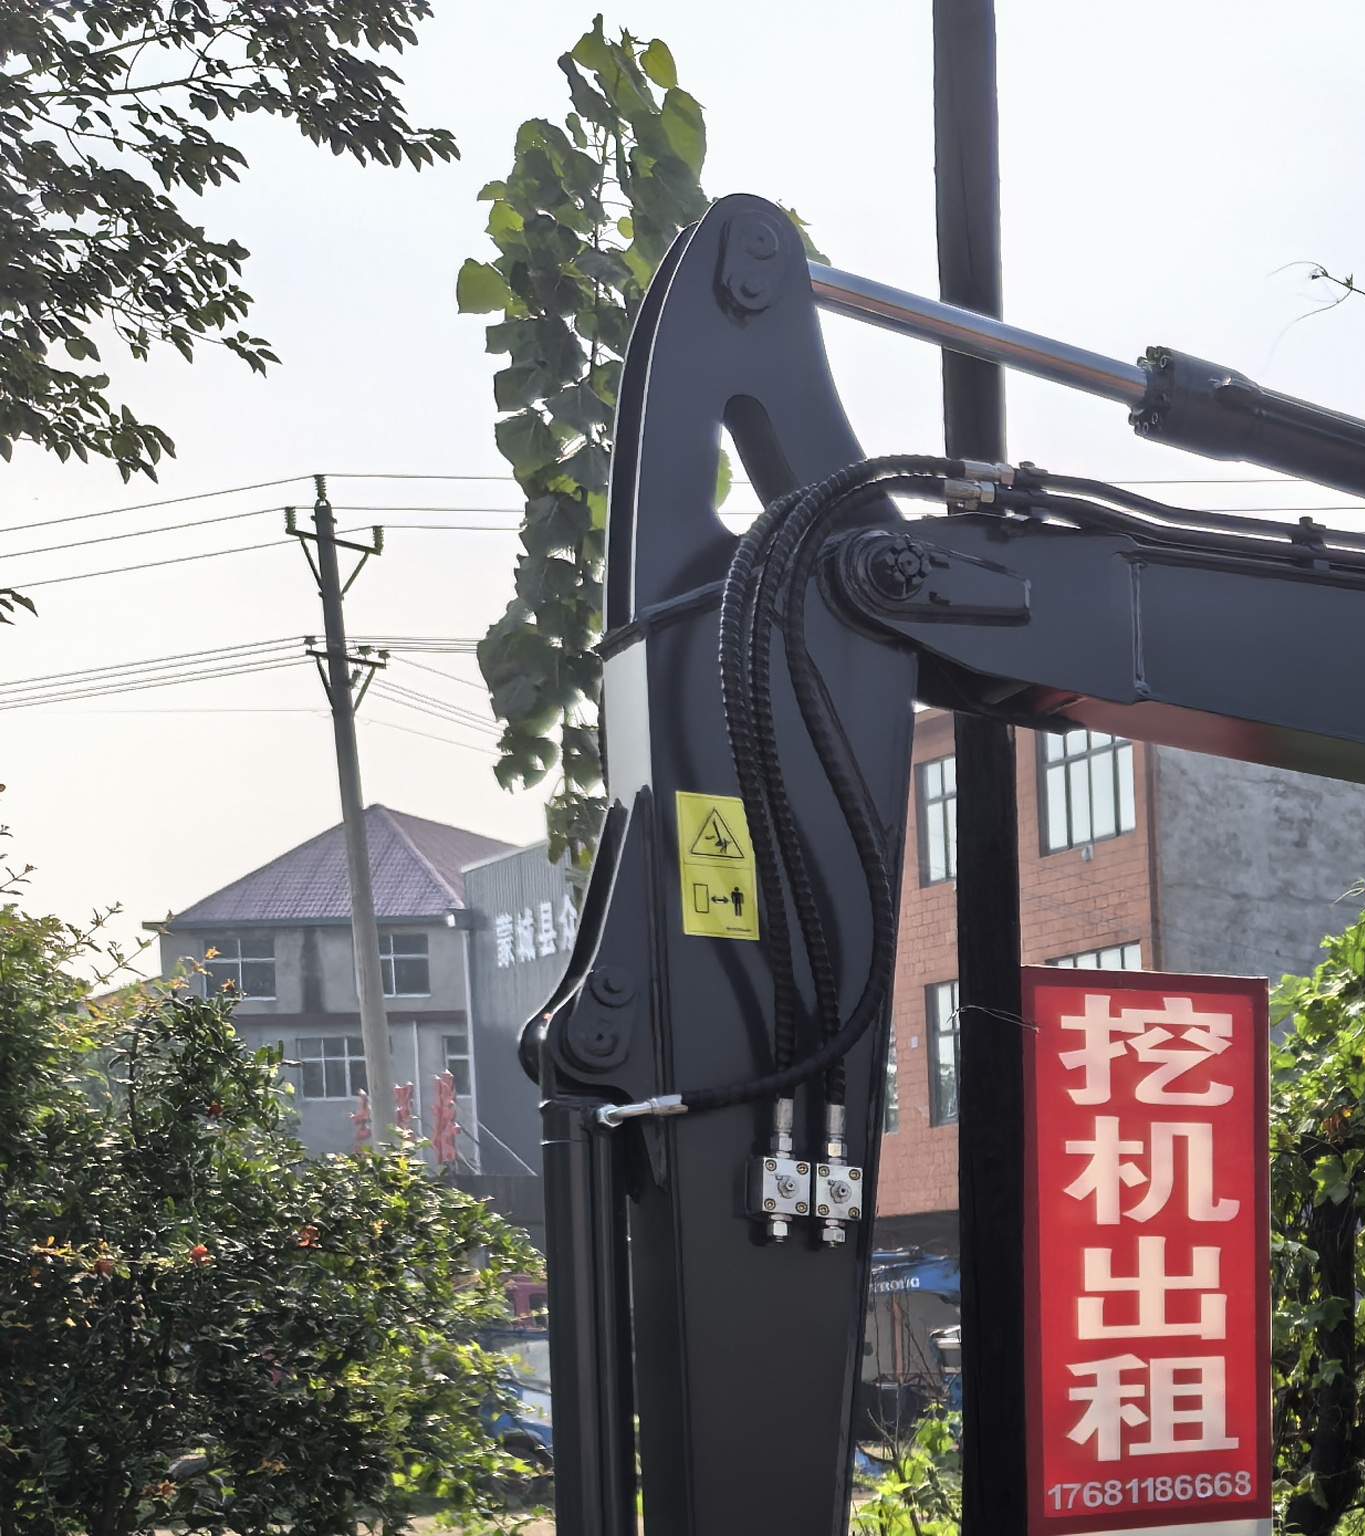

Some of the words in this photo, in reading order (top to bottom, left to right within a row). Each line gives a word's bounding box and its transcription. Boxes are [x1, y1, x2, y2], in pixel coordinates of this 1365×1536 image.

[1059, 994, 1240, 1461] 挖机出租
[1047, 1471, 1252, 1511] 17681186668
